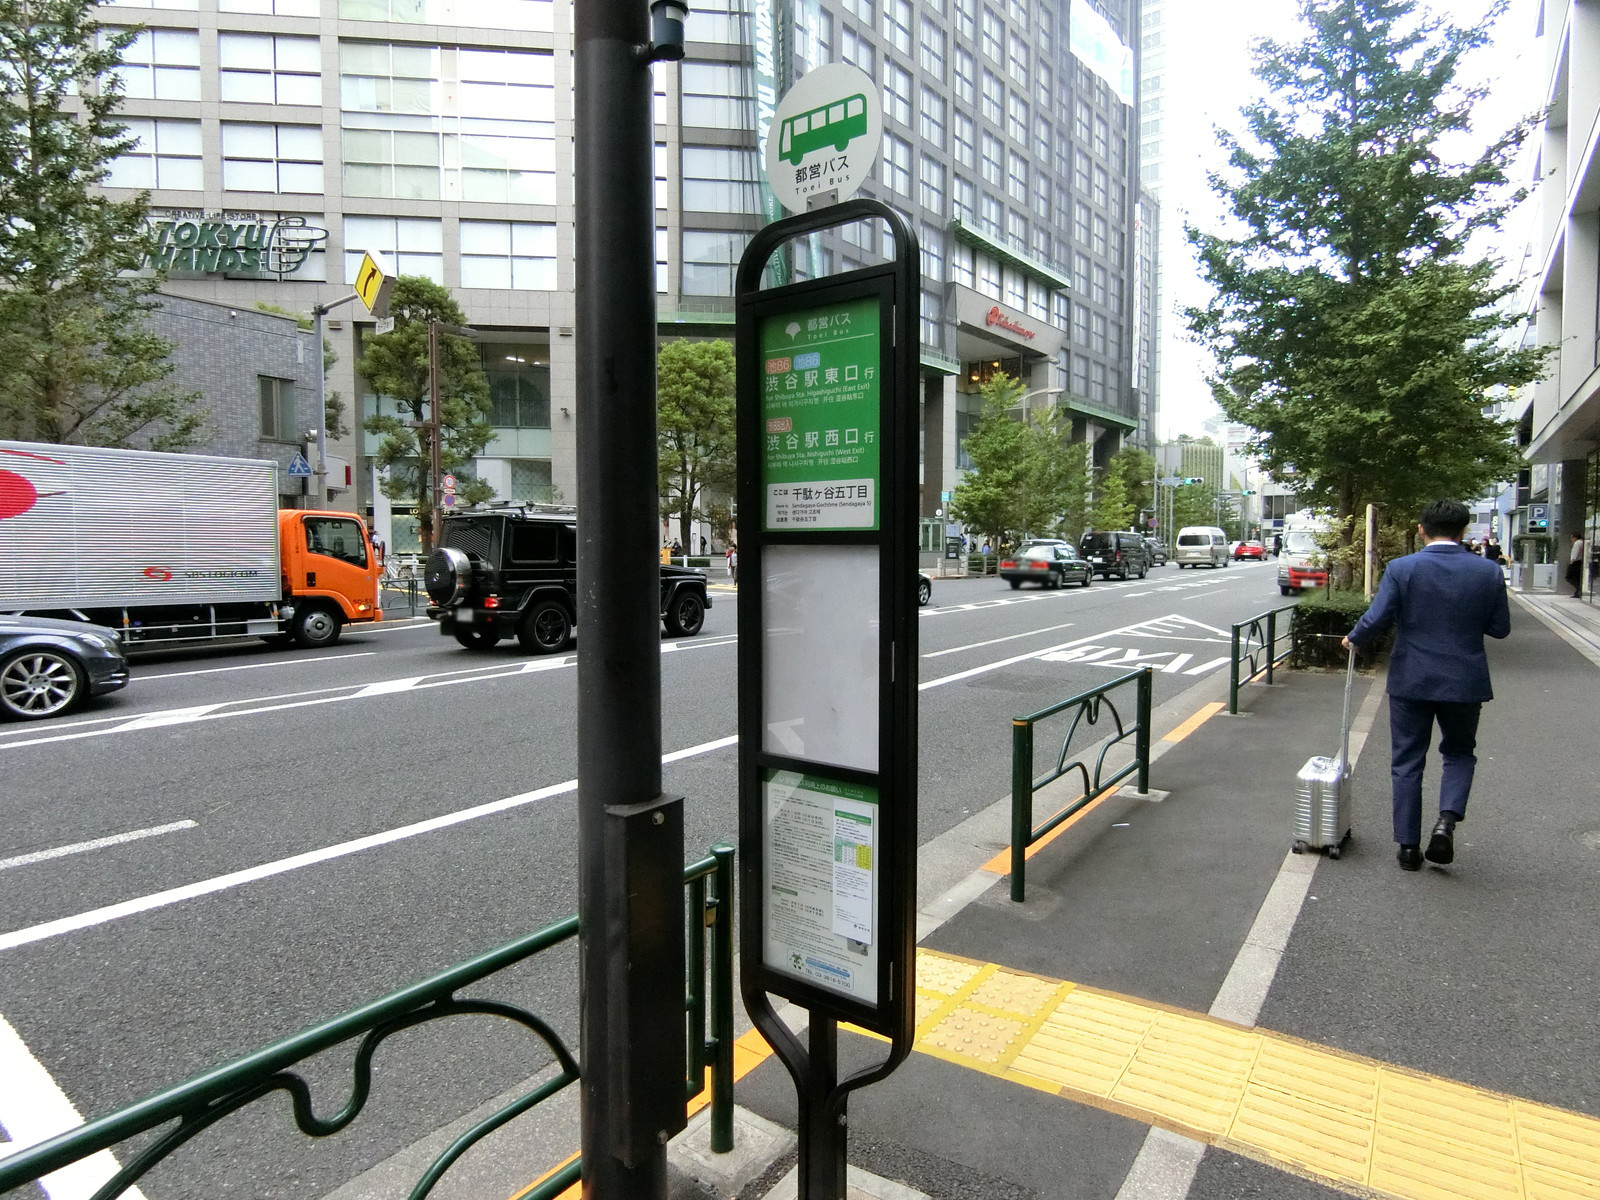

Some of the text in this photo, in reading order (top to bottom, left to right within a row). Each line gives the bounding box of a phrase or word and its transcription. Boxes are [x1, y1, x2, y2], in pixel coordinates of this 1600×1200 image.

[794, 155, 849, 184] 都営バス
[795, 174, 850, 195] Toei Bus
[165, 210, 204, 219] CREATIVE
[229, 212, 257, 221] STORE
[156, 221, 268, 248] TOKYU
[150, 246, 261, 273] HANDS
[807, 313, 851, 331] 都営バス
[807, 331, 827, 341] Toei
[765, 365, 874, 392] 渋谷駅東口行
[775, 393, 795, 402] Shibuya
[806, 387, 842, 398] Higashiguchi
[843, 384, 856, 393] (East
[857, 382, 870, 390] Exit)
[766, 428, 875, 451] 渋谷駅西口行
[775, 452, 796, 461] Shibuya
[806, 449, 835, 458] Nishiguchi
[835, 448, 851, 456] (West
[852, 446, 865, 454] Exit)
[792, 485, 868, 500] 千駄ヶ谷五丁目
[1533, 507, 1544, 518] P
